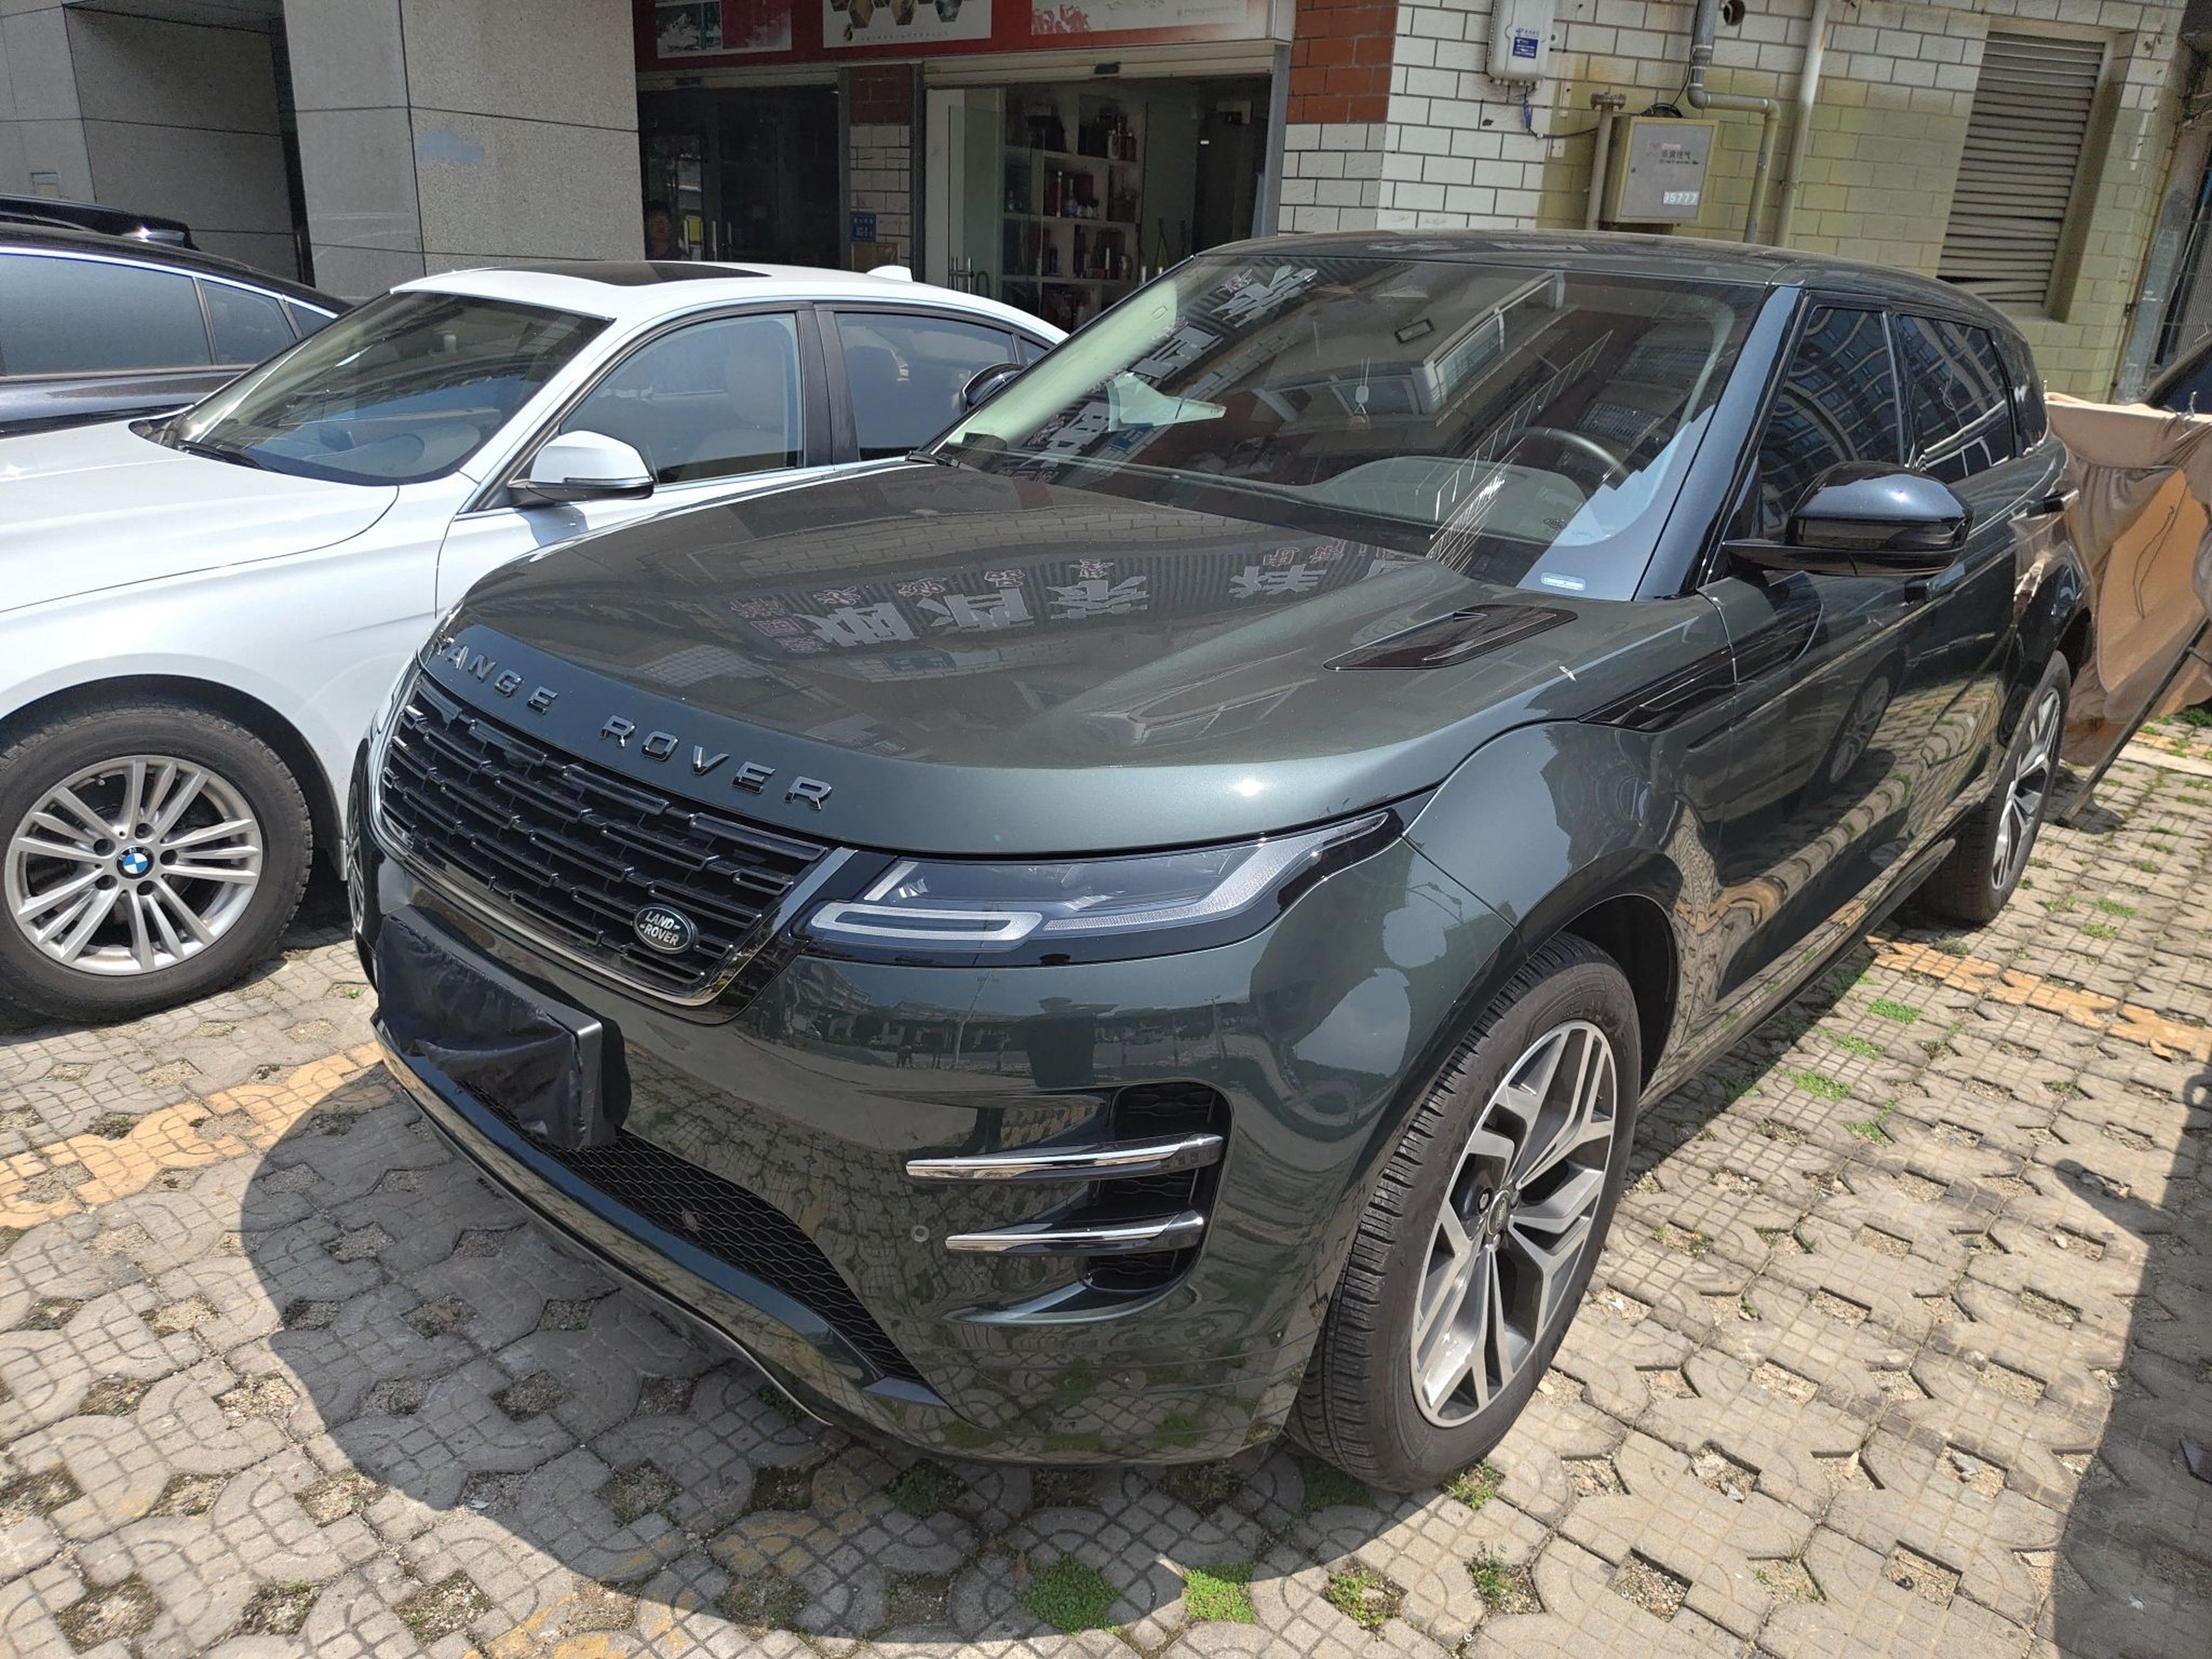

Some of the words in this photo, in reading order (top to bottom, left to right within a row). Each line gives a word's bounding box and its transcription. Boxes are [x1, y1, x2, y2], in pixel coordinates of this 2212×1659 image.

[600, 714, 832, 810] ROVER
[645, 911, 675, 930] LAND
[644, 924, 680, 946] ROVER
